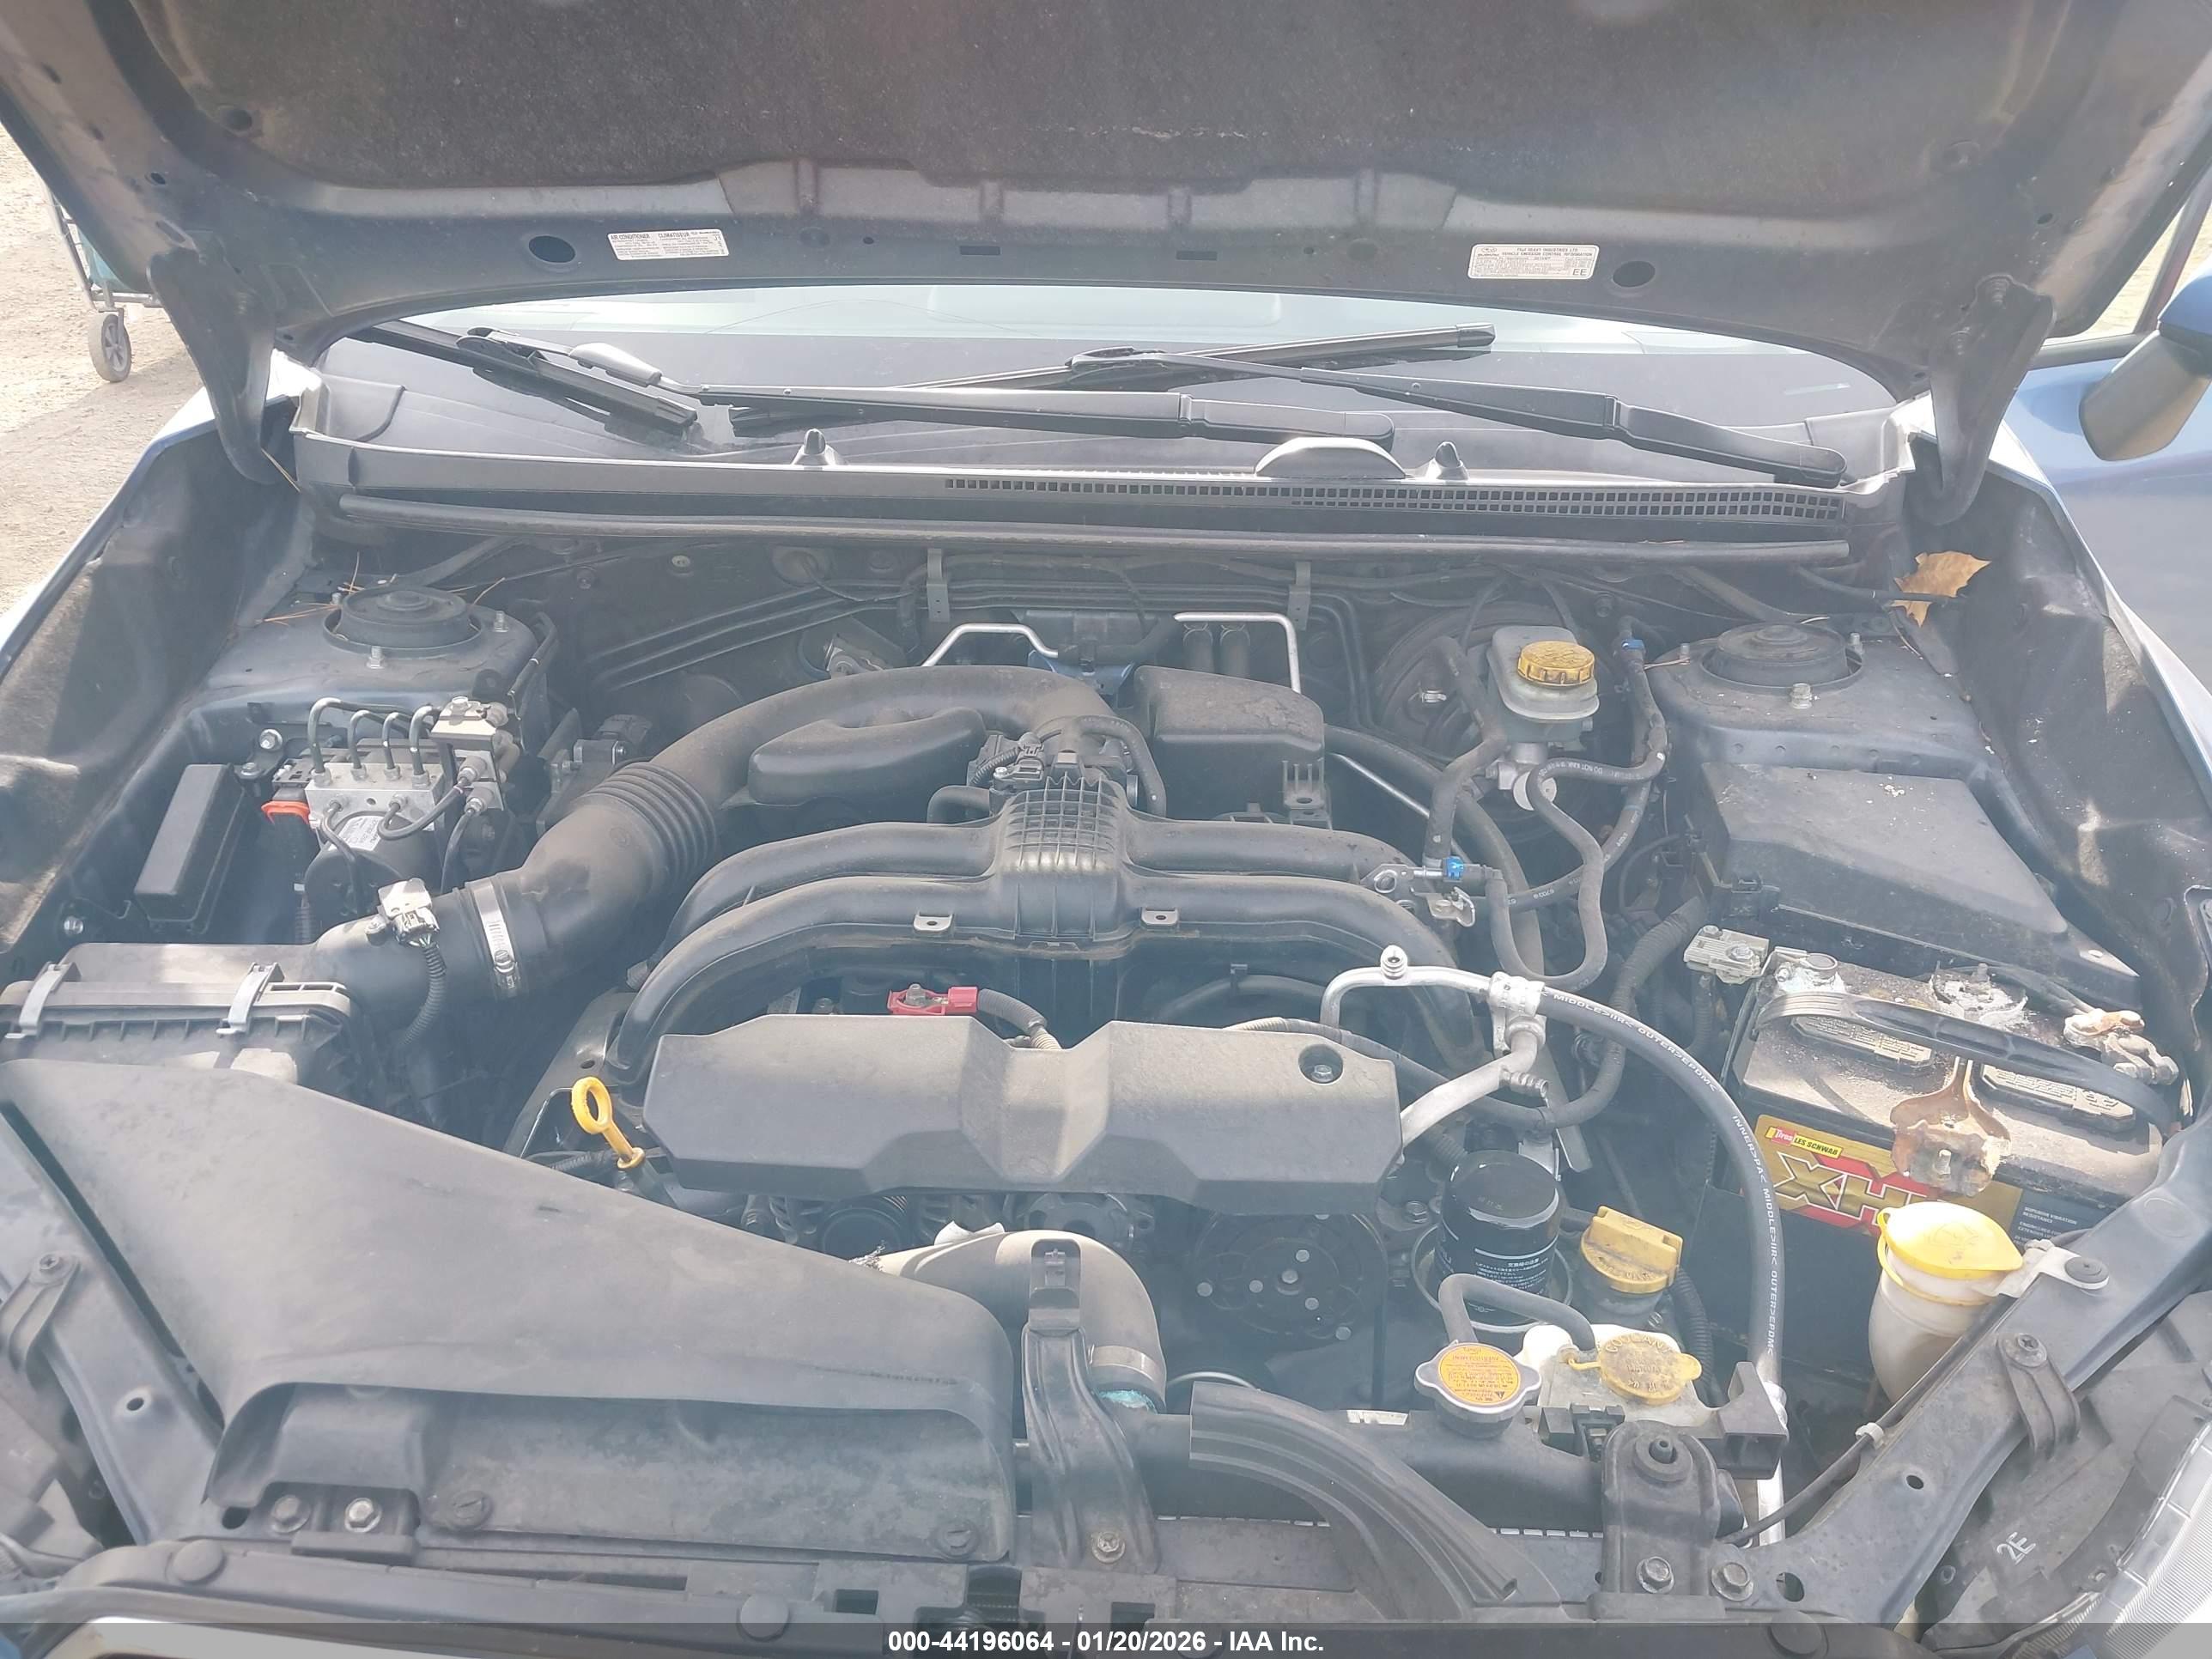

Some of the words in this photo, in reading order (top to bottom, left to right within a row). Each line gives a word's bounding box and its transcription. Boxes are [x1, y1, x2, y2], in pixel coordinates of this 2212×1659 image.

[1775, 1129, 1794, 1141] Tires
[1794, 1137, 1806, 1146] LES
[1807, 1141, 1838, 1156] SCHWAB
[1773, 1151, 1932, 1226] XH
